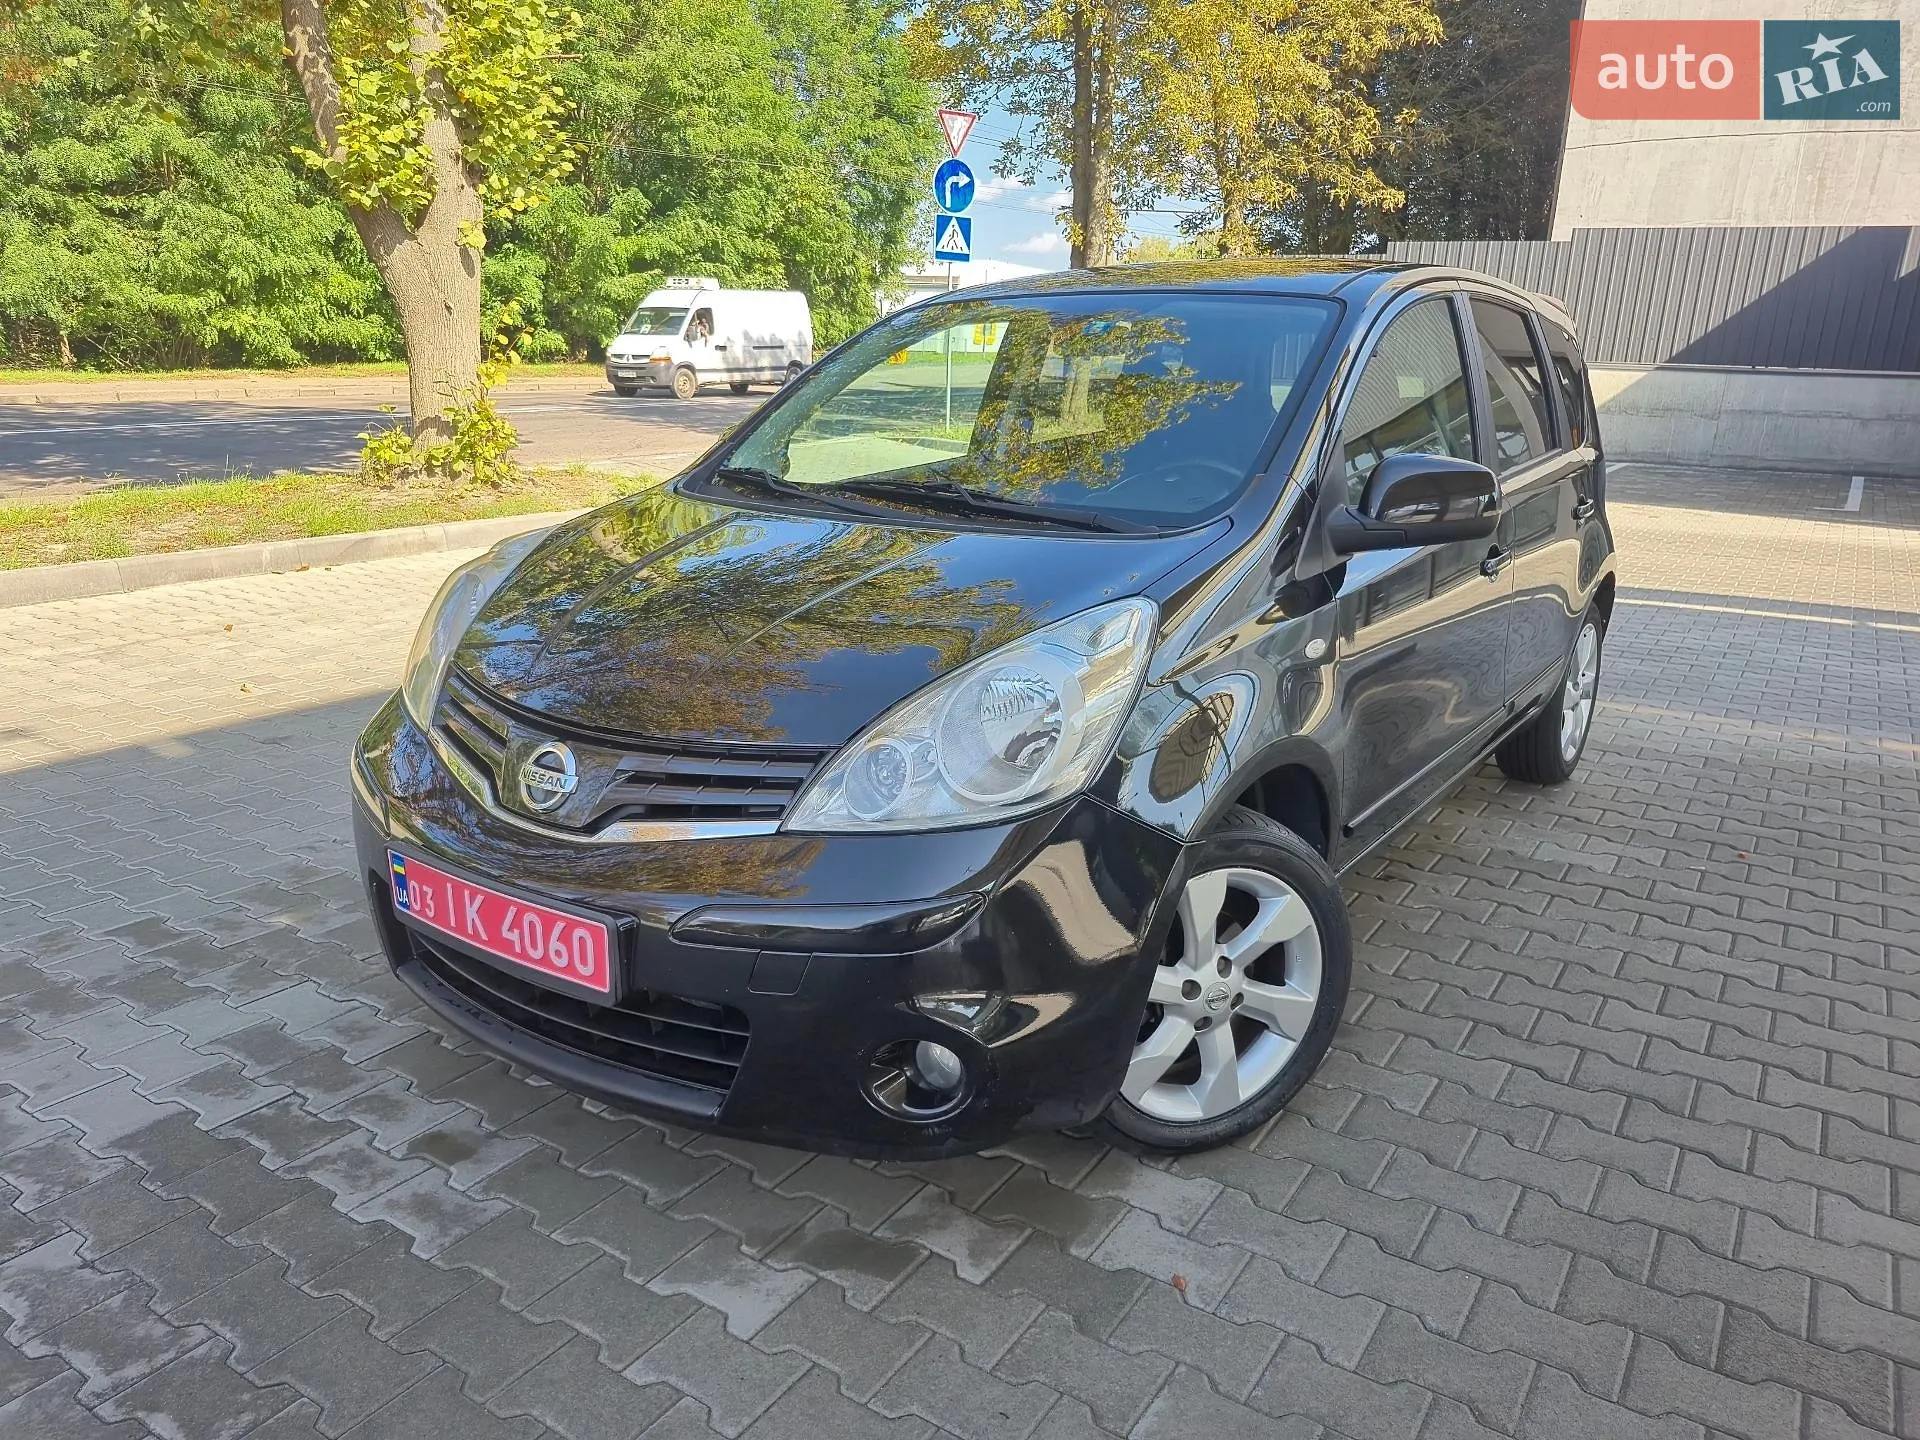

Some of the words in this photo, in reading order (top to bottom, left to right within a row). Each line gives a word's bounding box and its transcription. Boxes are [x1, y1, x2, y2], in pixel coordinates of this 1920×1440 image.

[521, 765, 569, 790] NISSAN
[396, 886, 410, 906] UA
[410, 880, 435, 918] 03
[446, 882, 489, 941] IK
[501, 905, 595, 977] 4060
